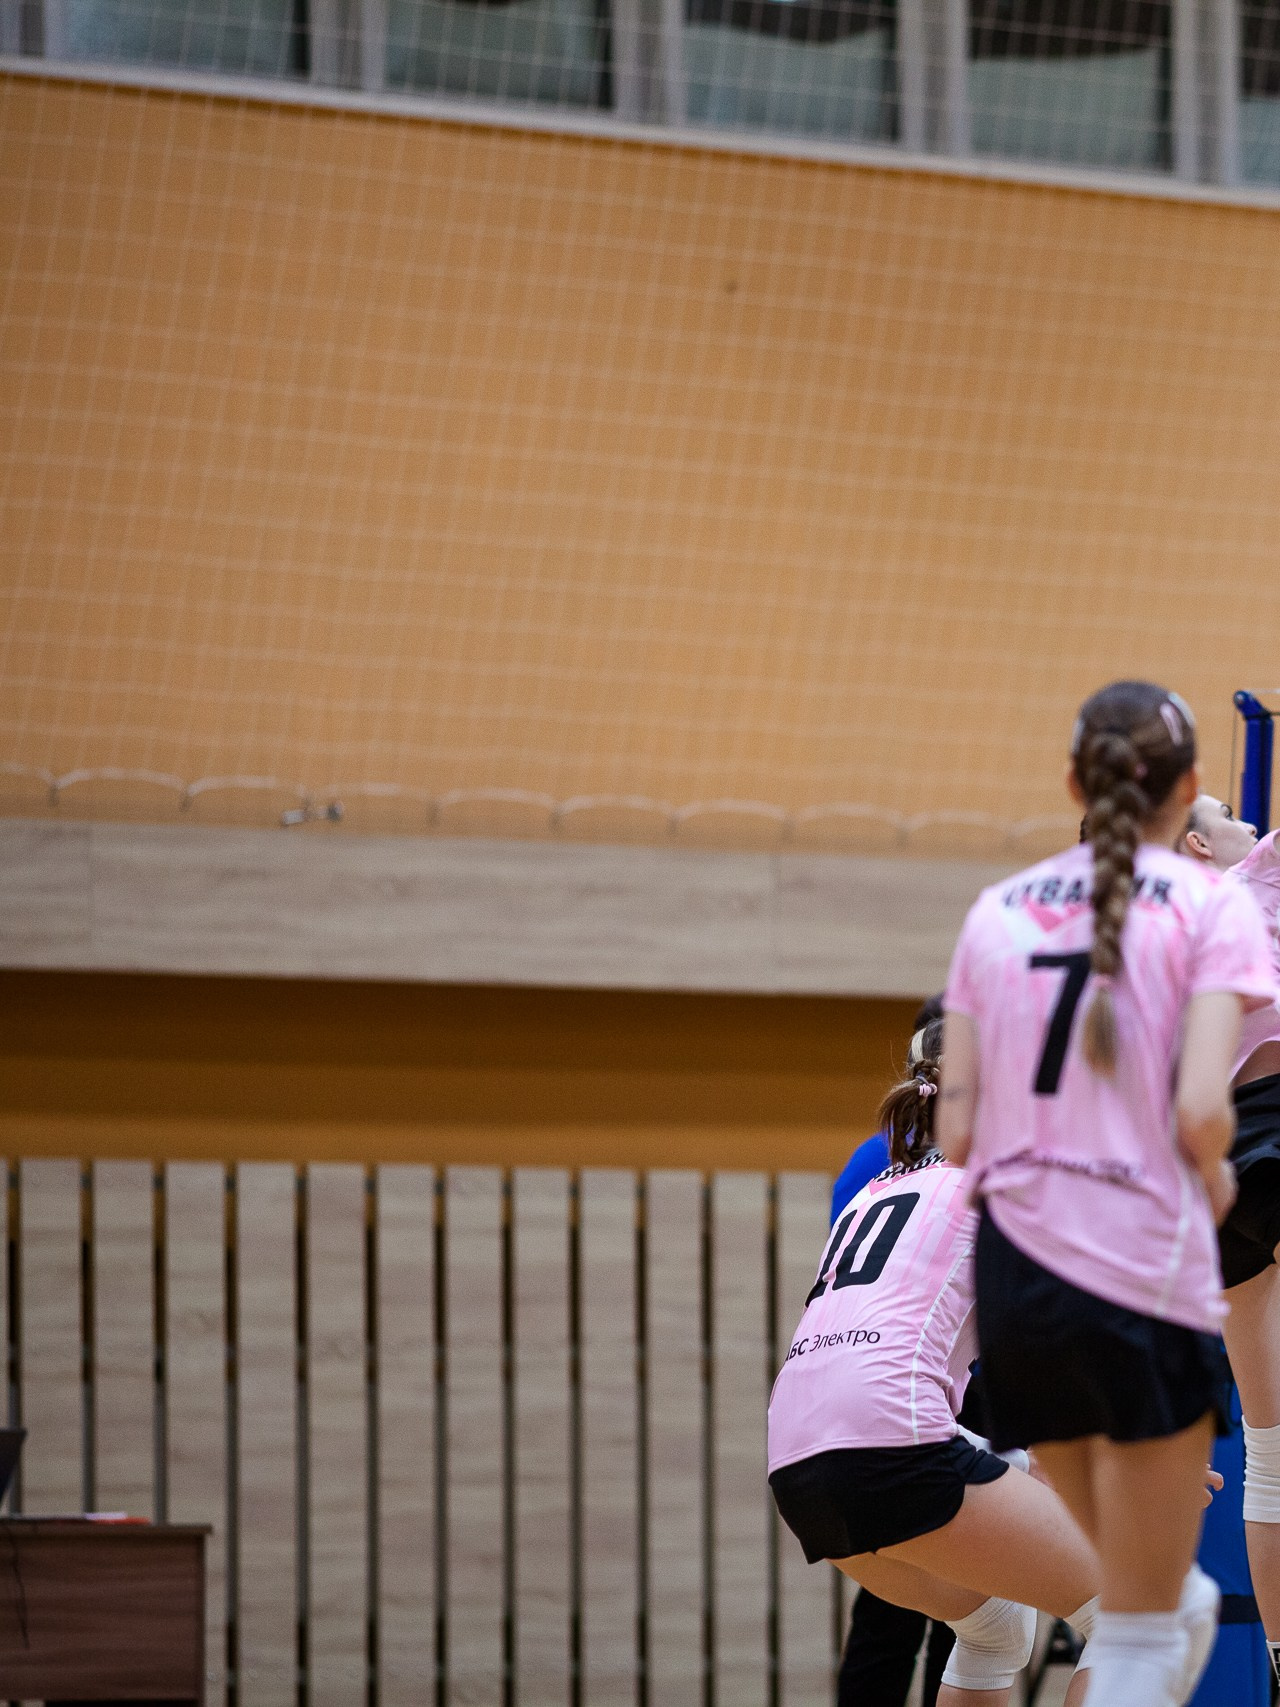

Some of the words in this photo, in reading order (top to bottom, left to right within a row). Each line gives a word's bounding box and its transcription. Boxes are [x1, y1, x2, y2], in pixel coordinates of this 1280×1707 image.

[1028, 951, 1093, 1096] 7
[805, 1192, 920, 1308] 10
[785, 1338, 809, 1362] БС
[809, 1329, 881, 1352] Электро
